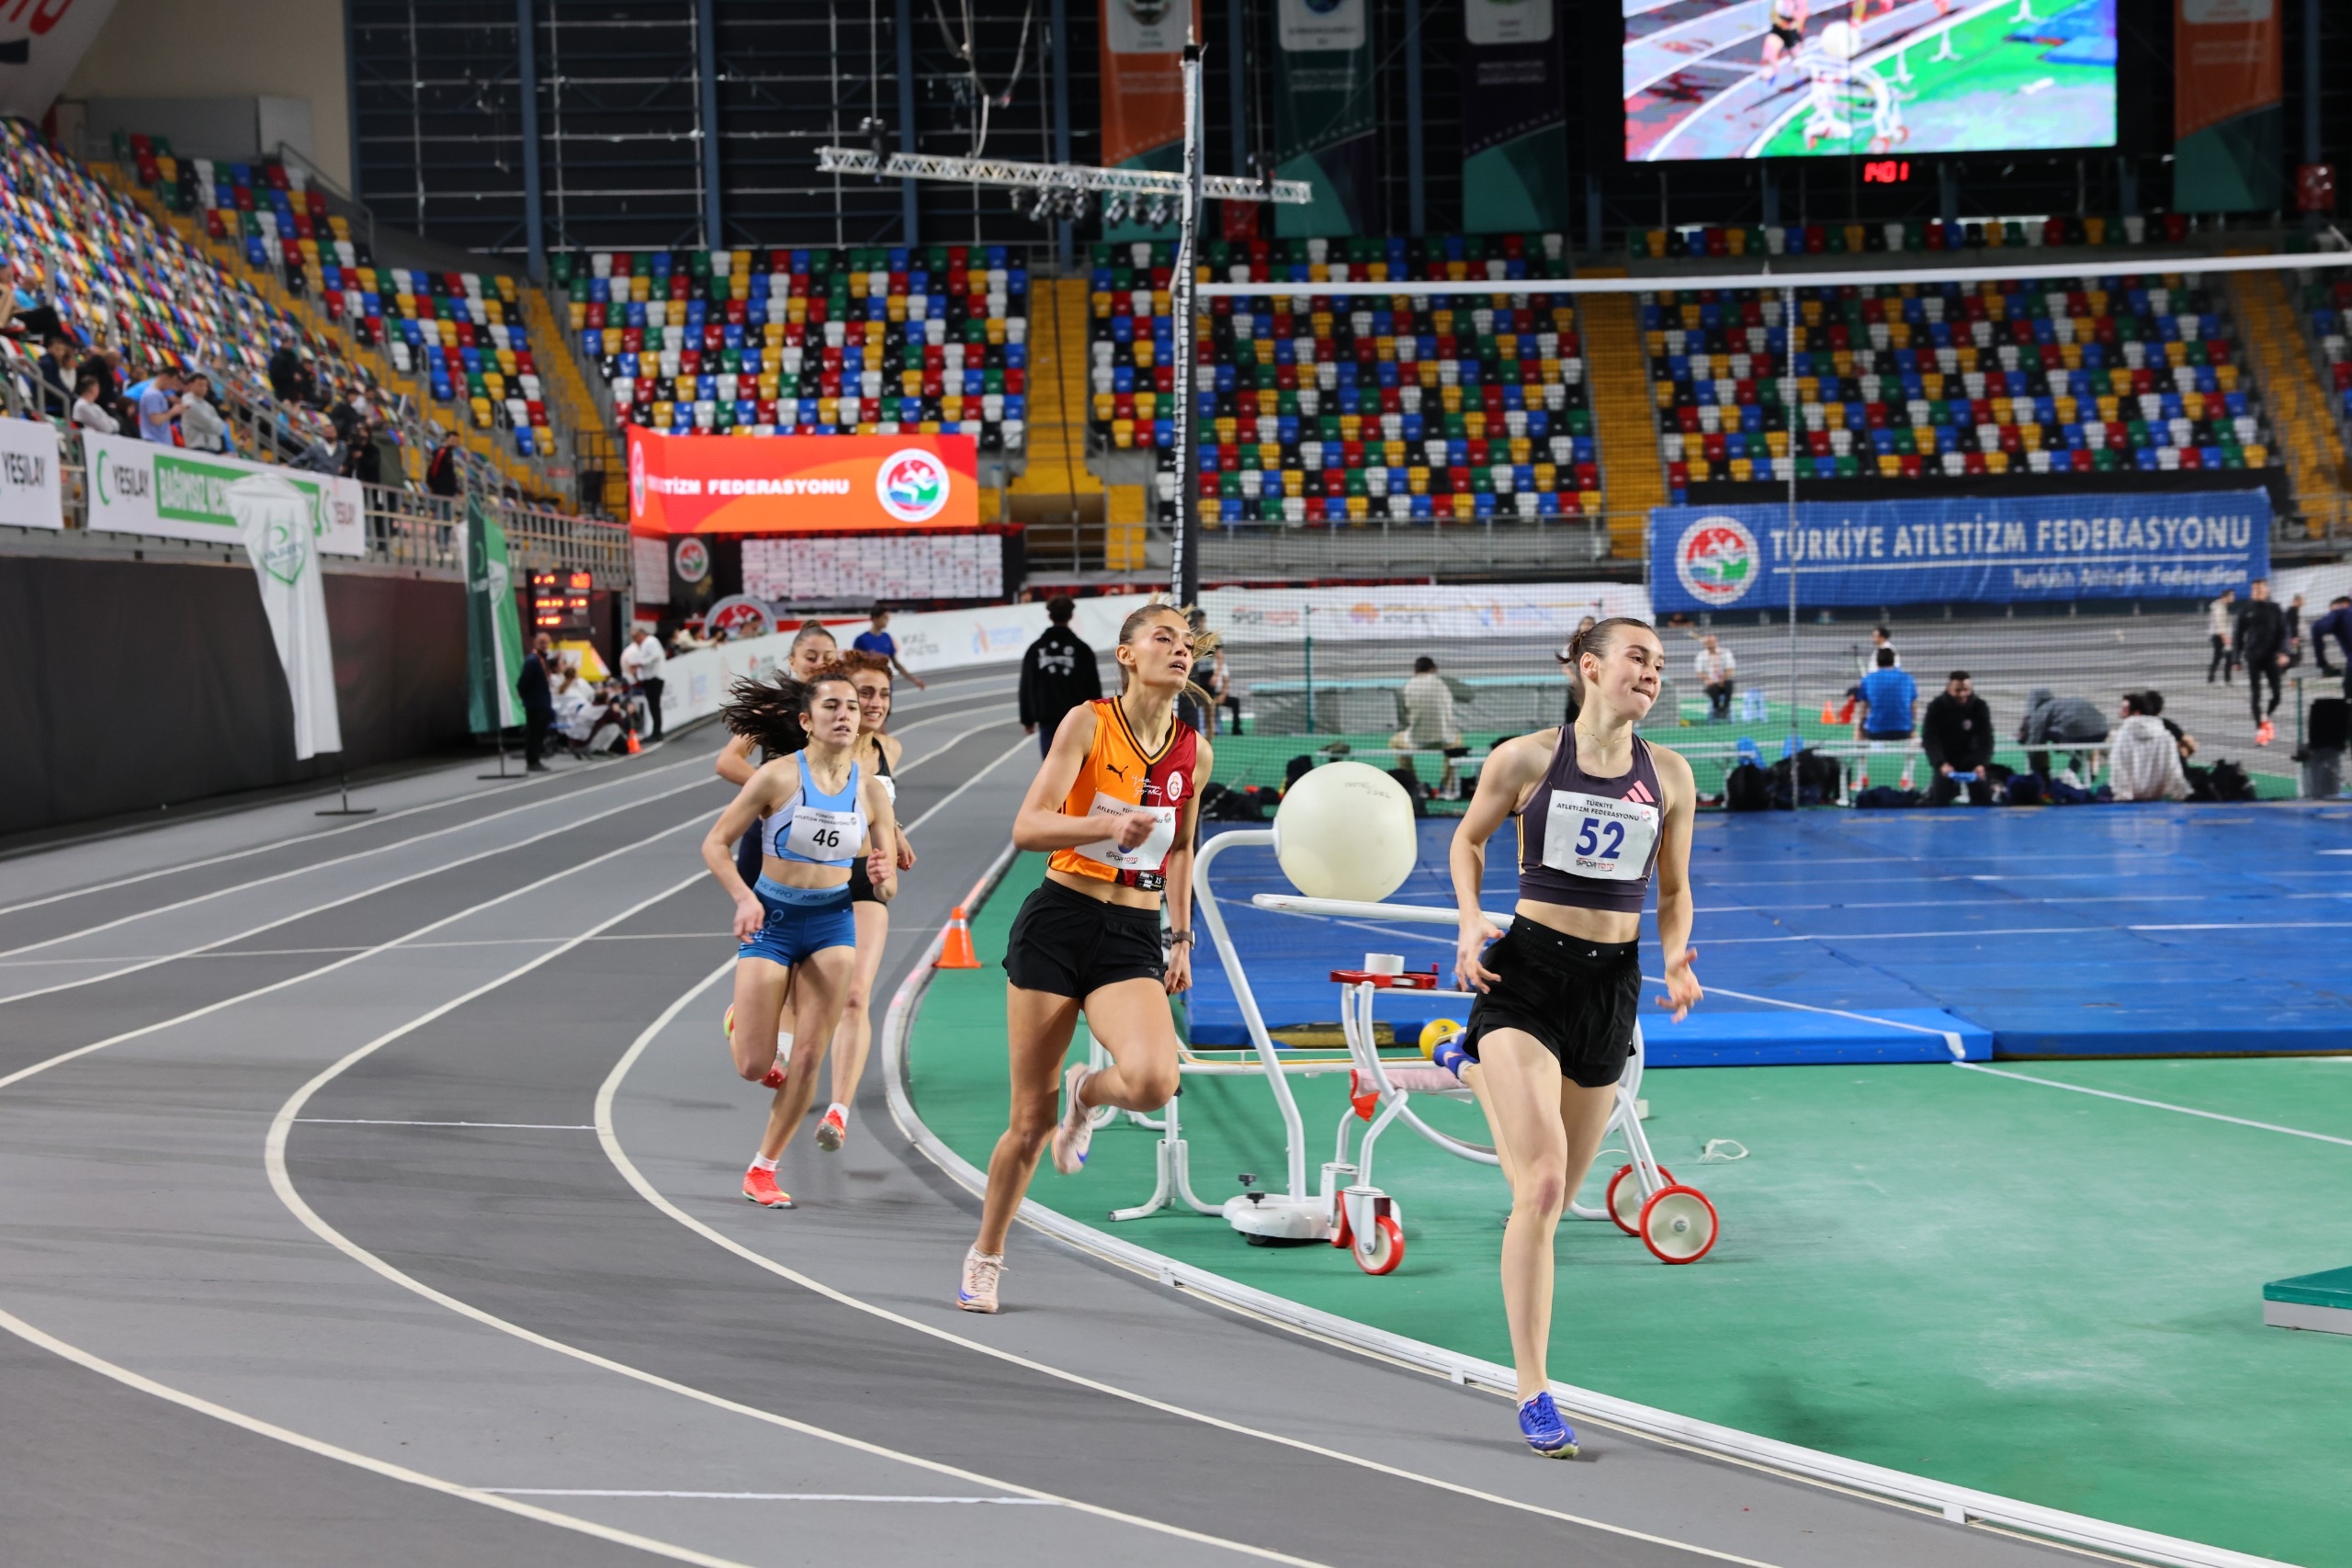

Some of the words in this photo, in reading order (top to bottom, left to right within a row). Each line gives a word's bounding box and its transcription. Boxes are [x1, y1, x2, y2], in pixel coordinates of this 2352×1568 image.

[707, 479, 850, 495] FEDERASYONU
[1770, 519, 1883, 561] TÜRKİYE
[1894, 513, 2027, 557] ATLETİZM
[2037, 516, 2251, 552] FEDERASYONU
[1556, 803, 1589, 813] ATLETİZM
[1591, 808, 1640, 821] FEDERASYONU
[1586, 799, 1613, 809] TÜRKİYE
[812, 829, 840, 848] 46
[1575, 818, 1624, 859] 52
